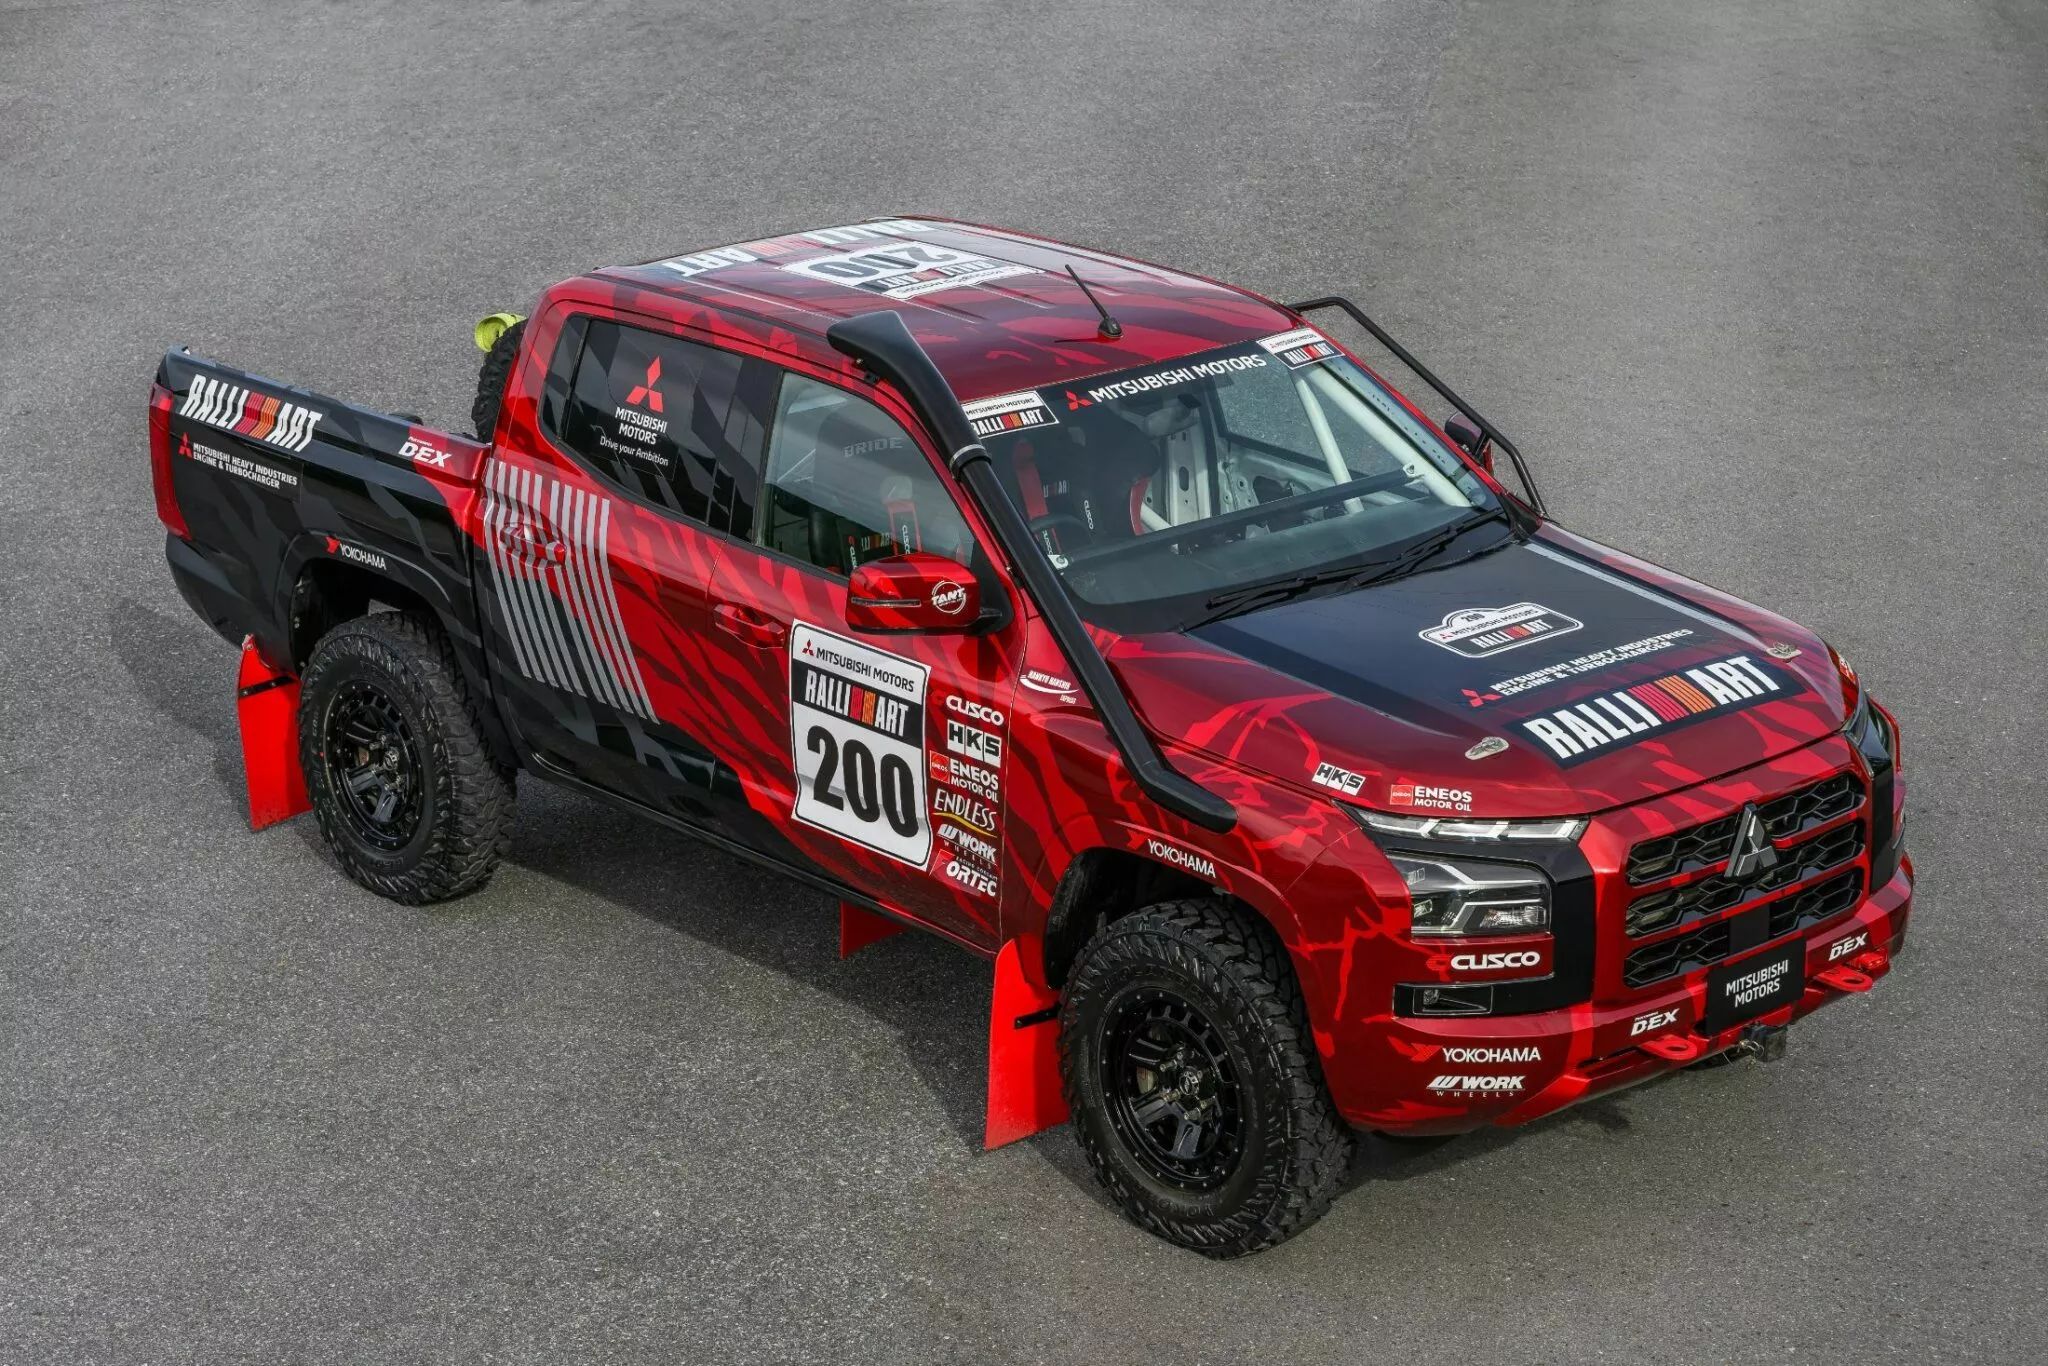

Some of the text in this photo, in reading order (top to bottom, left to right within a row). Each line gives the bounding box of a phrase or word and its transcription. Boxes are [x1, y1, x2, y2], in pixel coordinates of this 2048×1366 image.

[1088, 354, 1267, 402] MITSUBISHI MOTORS
[615, 407, 668, 433] MITSUBISHI
[966, 397, 1035, 416] MITSUBISHI MOTORS
[619, 422, 657, 445] MOTORS
[842, 437, 904, 458] BRIDE
[193, 442, 298, 486] MITSUBISHI HEAVY INDUSTRIES
[398, 441, 452, 468] DEX
[600, 435, 669, 467] Drive your Ambition
[193, 451, 280, 489] ENGINE & TURBOCHARGER
[1084, 500, 1094, 530] CUSCO
[340, 543, 387, 571] YOKOHAMA
[1452, 608, 1539, 636] MITSUBISHI MOTORS
[816, 647, 915, 692] MITSUBISHI MOTORS
[1489, 628, 1694, 692] MITSUBISHI HEAVY INDUSTRIES
[1499, 641, 1676, 696] ENGINE & TURBOCHARGER
[946, 695, 1004, 726] CUSCO
[949, 722, 1000, 758] HKS
[807, 725, 919, 838] 200
[950, 758, 999, 791] ENEOS
[951, 775, 999, 804] MOTOR OIL
[1316, 764, 1363, 790] HKS
[1414, 785, 1473, 803] ENEOS
[1414, 799, 1472, 812] MOTOR OIL
[934, 788, 997, 832] ENDLESS
[1147, 838, 1217, 879] YOKOHAMA
[1450, 951, 1541, 970] CUSCO
[1829, 932, 1868, 961] DEX
[1726, 959, 1789, 997] MITSUBISHI
[1734, 977, 1780, 1008] MOTORS
[1630, 1007, 1680, 1037] DEX
[1442, 1046, 1542, 1063] YOKOHAMA
